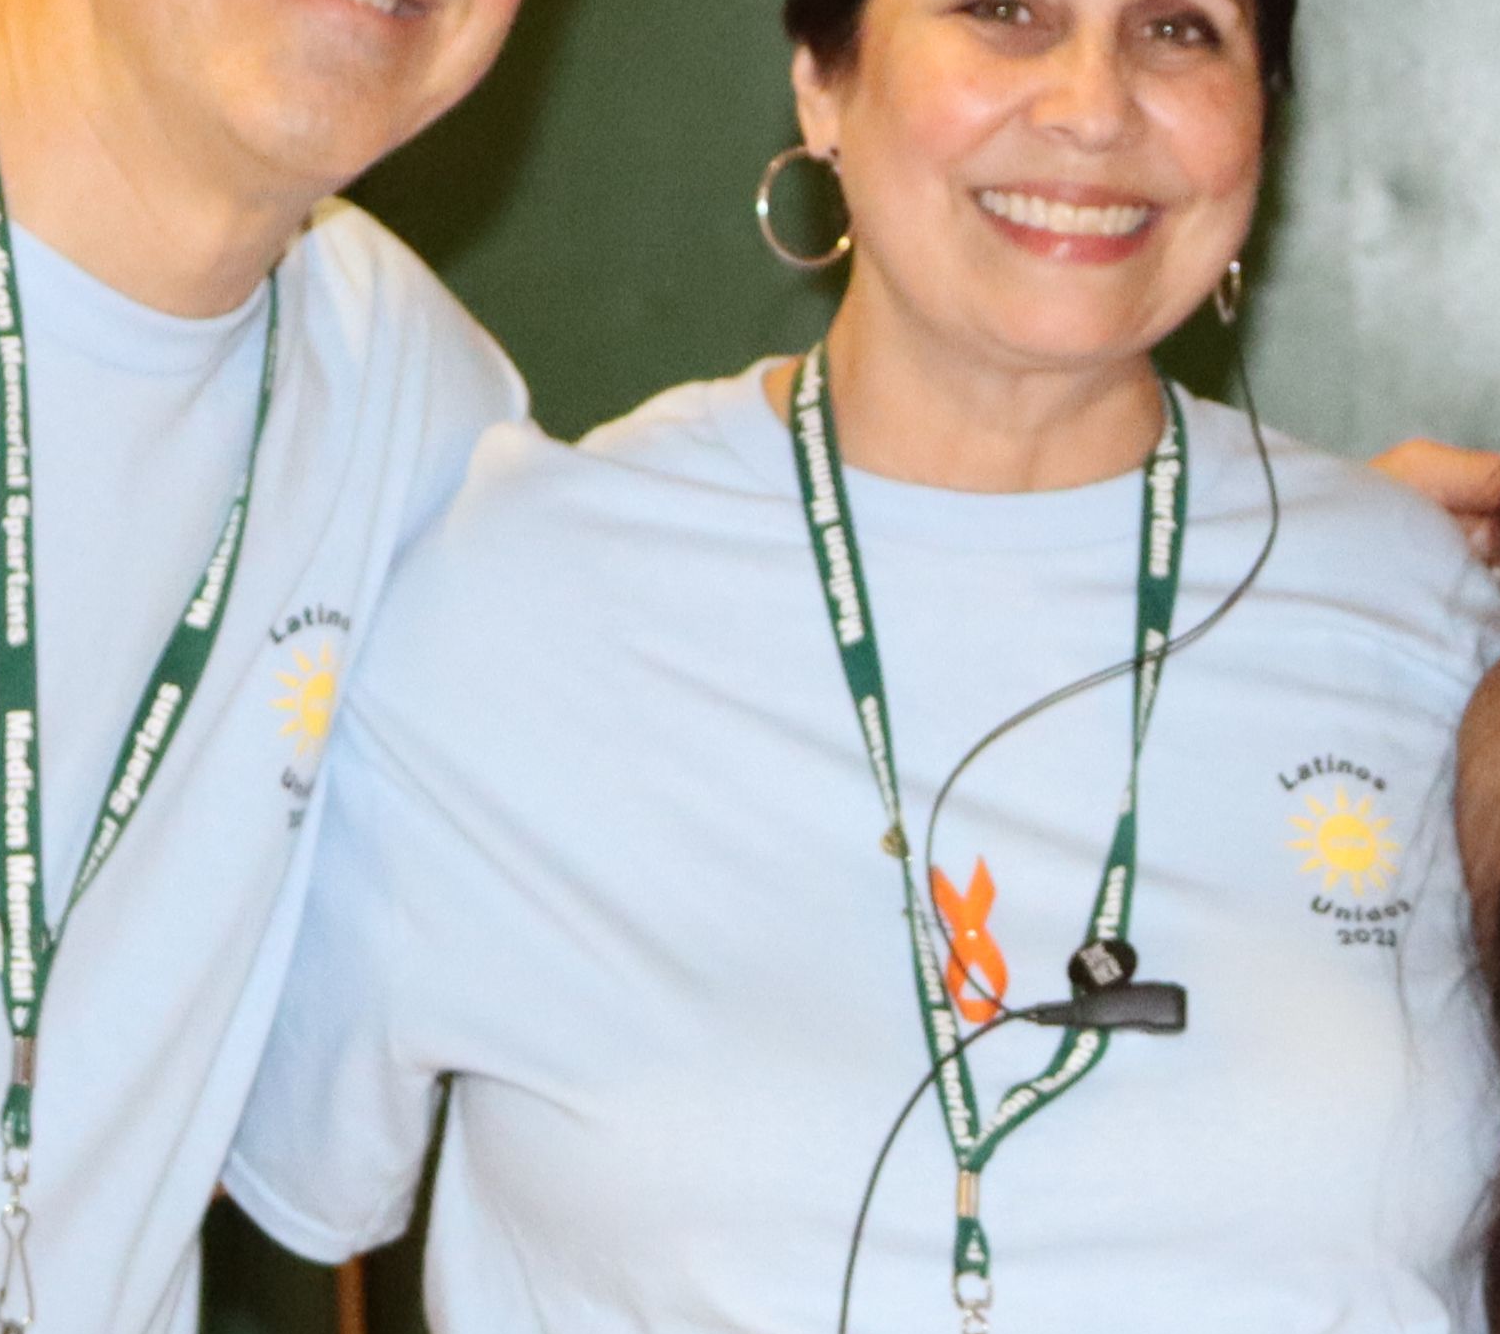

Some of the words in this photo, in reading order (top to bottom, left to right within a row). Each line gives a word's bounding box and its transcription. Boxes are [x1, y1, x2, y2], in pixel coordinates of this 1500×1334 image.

[797, 406, 841, 525] Memorial
[1150, 458, 1181, 578] Spartans
[3, 494, 30, 647] Spartans
[822, 524, 865, 645] Madison
[4, 709, 34, 849] Madison
[109, 682, 183, 817] Spartans
[5, 854, 36, 1001] Memorial
